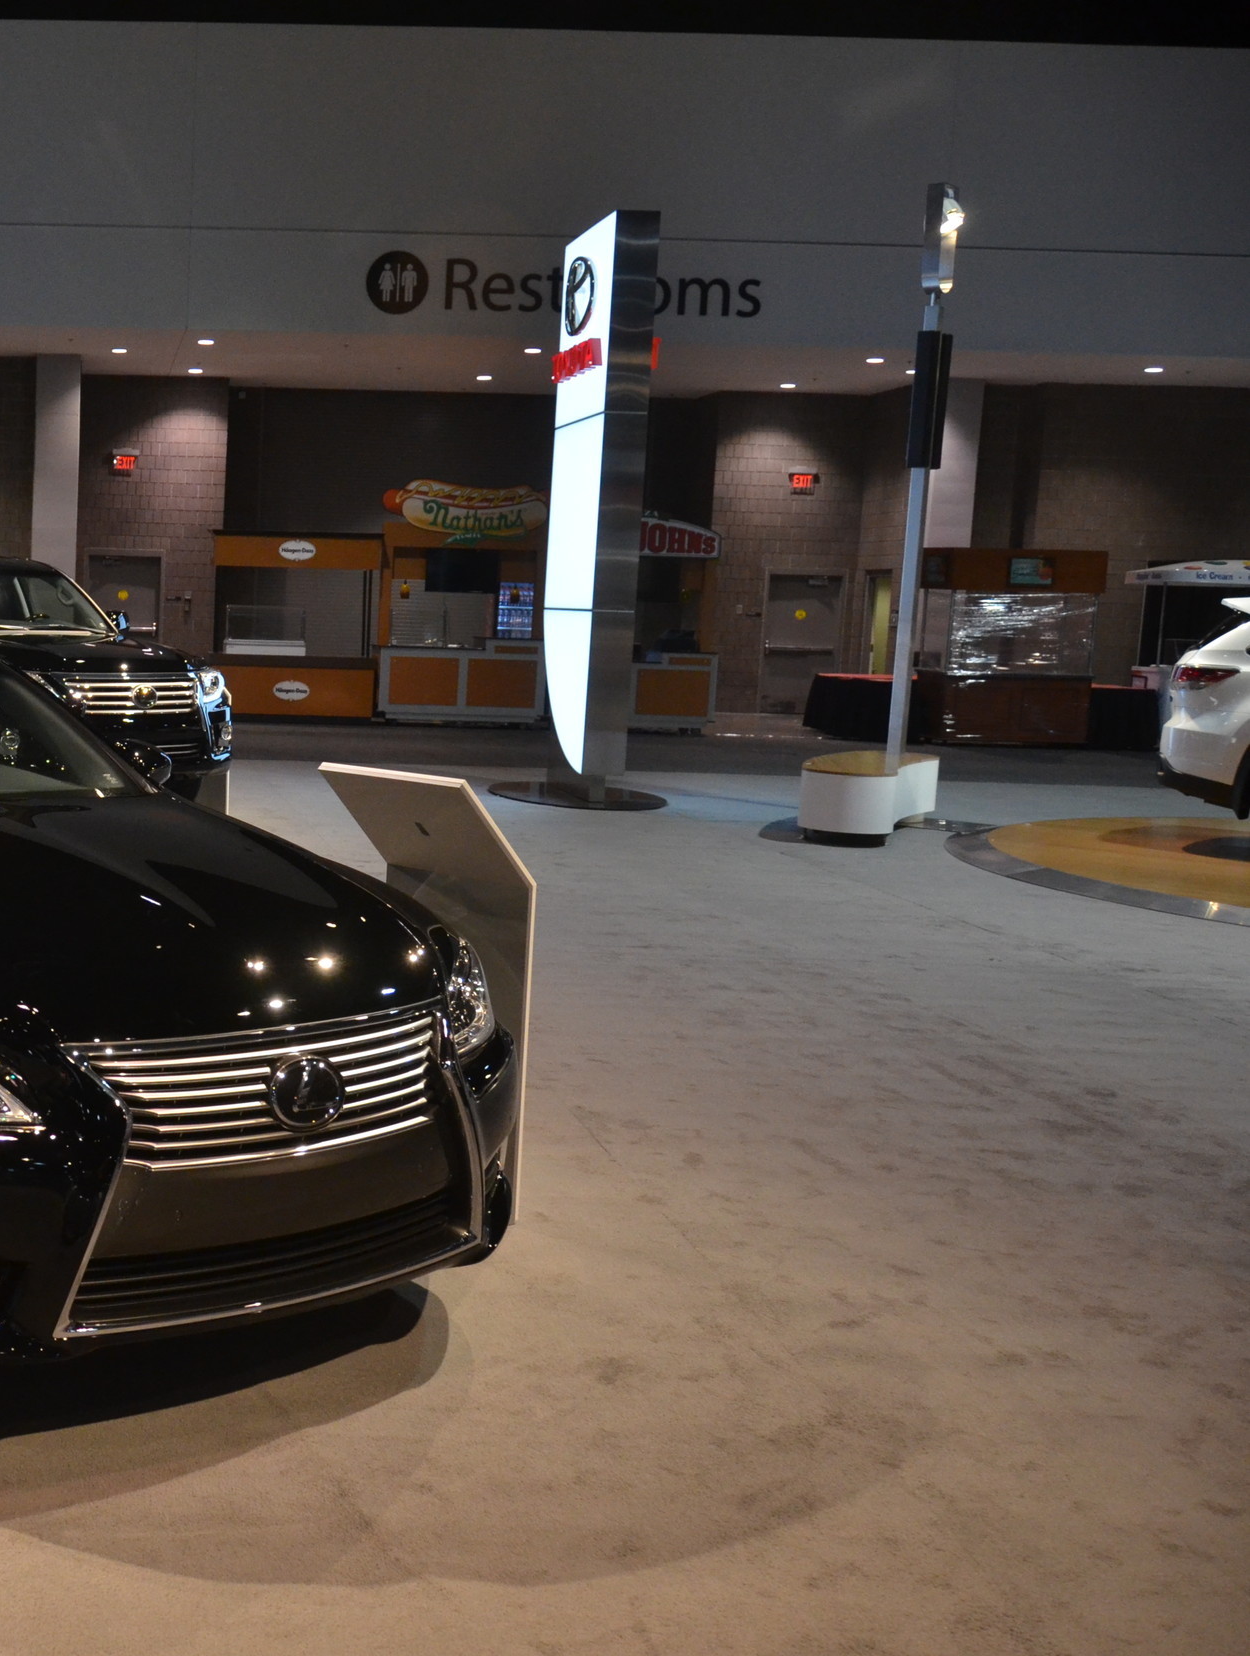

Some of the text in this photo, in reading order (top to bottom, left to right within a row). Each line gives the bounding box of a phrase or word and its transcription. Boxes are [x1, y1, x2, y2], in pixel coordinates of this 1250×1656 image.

[443, 257, 762, 318] Restms
[116, 456, 135, 469] EXIT
[793, 474, 813, 488] EXIT
[422, 498, 525, 531] Nathan's
[1196, 572, 1234, 581] Ice Cream
